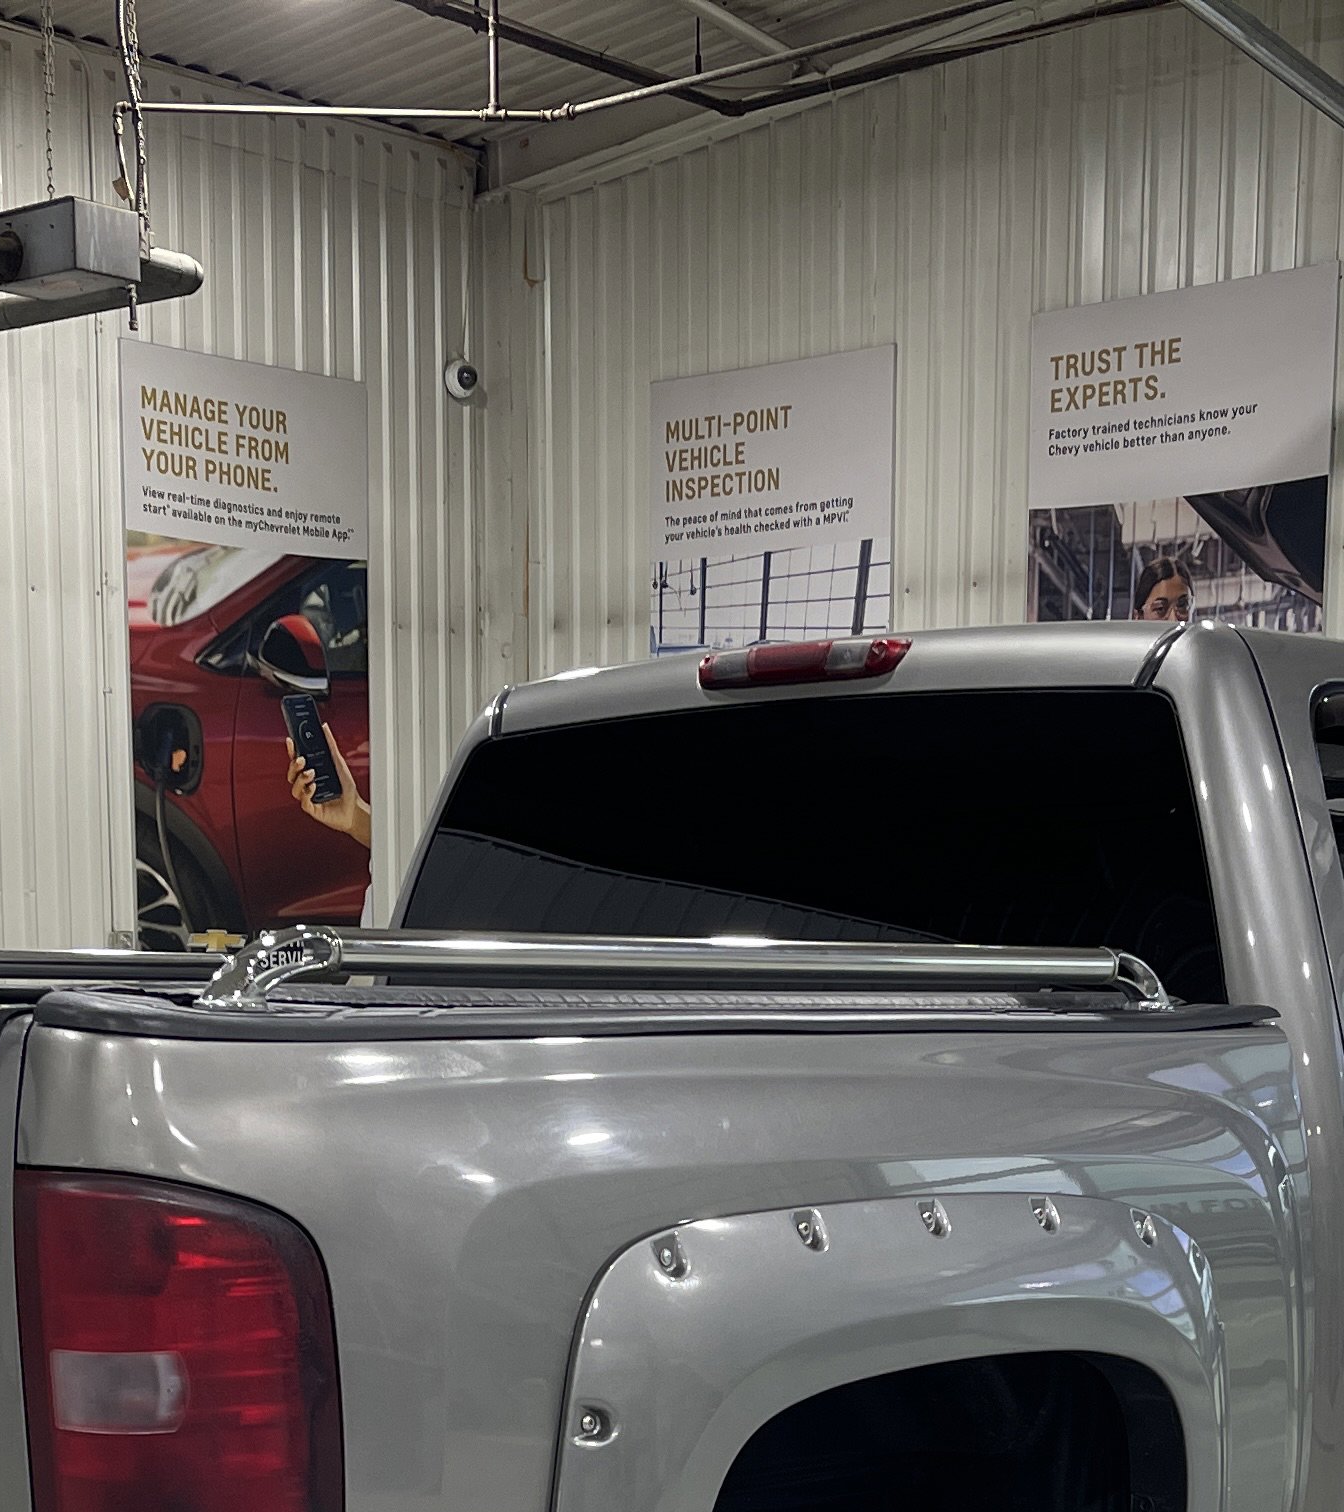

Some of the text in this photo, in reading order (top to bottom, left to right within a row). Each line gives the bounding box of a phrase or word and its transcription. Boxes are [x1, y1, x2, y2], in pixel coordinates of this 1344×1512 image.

[1050, 337, 1182, 381] TRUST THE
[140, 385, 288, 434] MANAGE YOUR
[1050, 374, 1166, 413] EXPERTS.
[666, 405, 792, 444] MULTI-POINT
[1048, 404, 1258, 440] Factory trained technicians know your
[140, 416, 290, 465] VEHICLE FROM
[665, 441, 746, 473] VEHICLE
[1047, 426, 1231, 456] Chevy vehicle better than anyone.
[141, 446, 279, 493] YOUR PHONE.
[666, 467, 780, 503] INSPECTION
[141, 486, 340, 524] View real-time diagnostics and enjoy remote
[664, 497, 853, 528] The peace of mind that comes from getting
[171, 509, 211, 523] available
[214, 516, 225, 525] on
[227, 515, 242, 527] the
[245, 520, 300, 535] myChevrolet
[302, 524, 329, 538] Mobile
[664, 533, 683, 544] your
[685, 526, 722, 540] vehicle's
[724, 523, 751, 535] health
[753, 518, 790, 532] checked
[792, 516, 812, 527] with
[815, 517, 820, 525] a
[260, 949, 313, 969] SERVI
